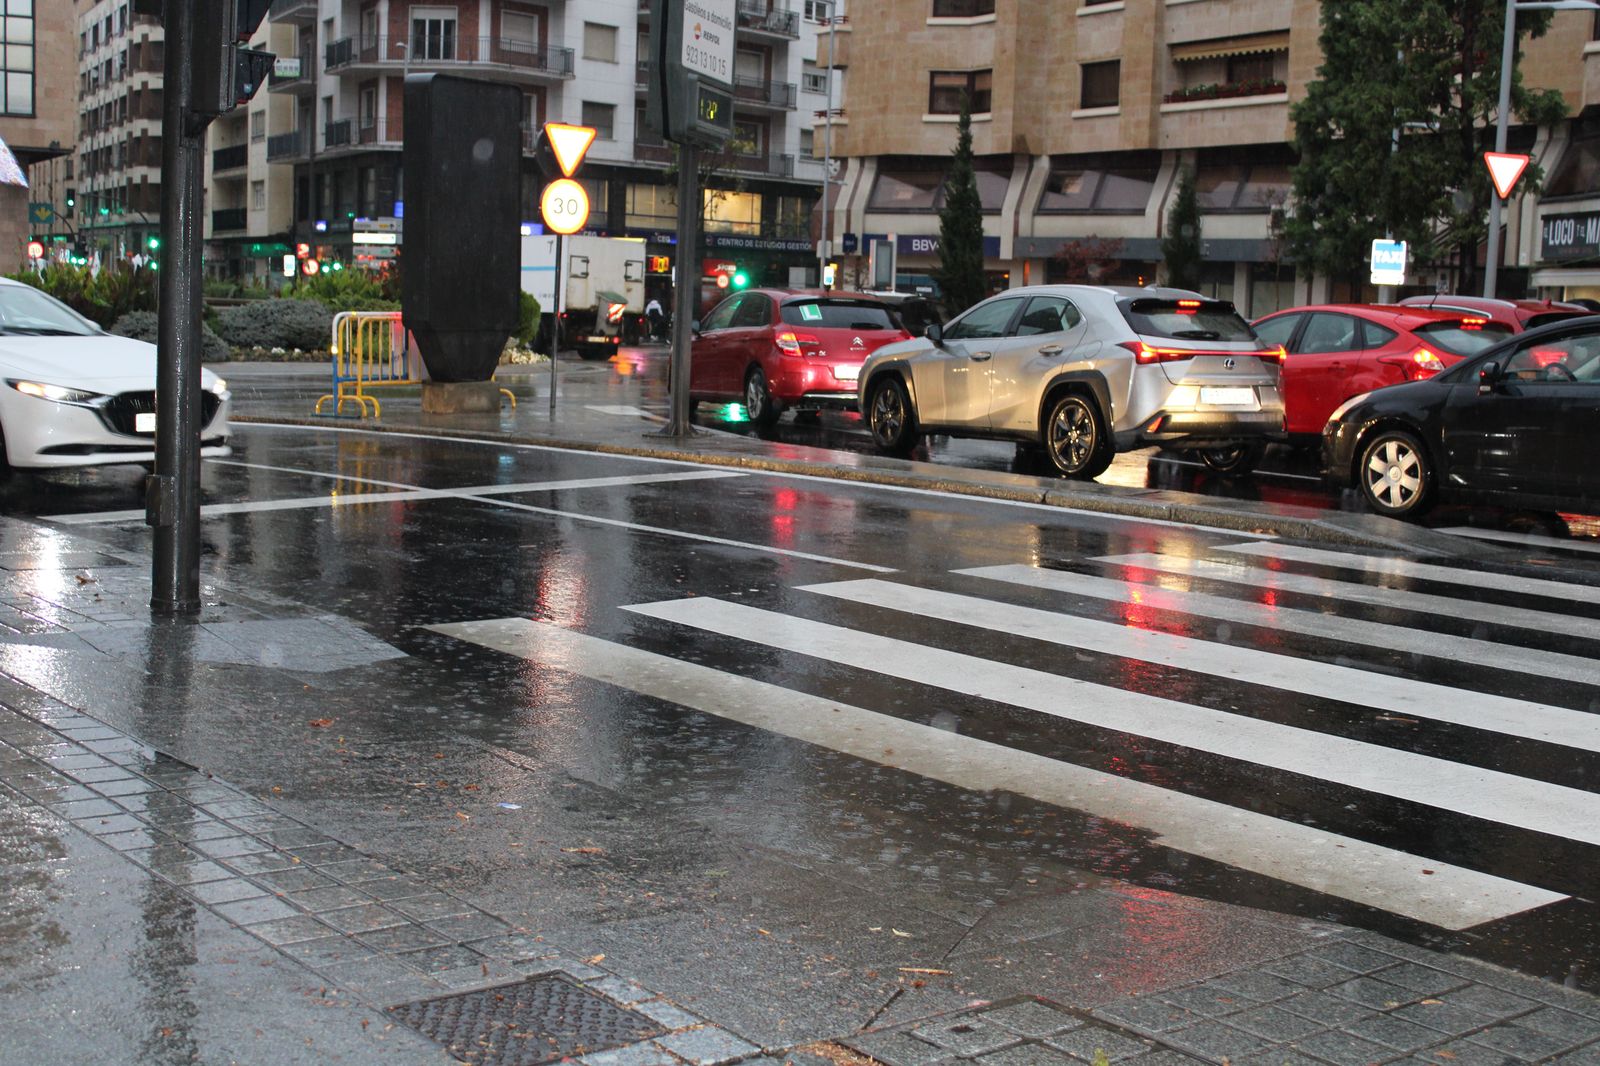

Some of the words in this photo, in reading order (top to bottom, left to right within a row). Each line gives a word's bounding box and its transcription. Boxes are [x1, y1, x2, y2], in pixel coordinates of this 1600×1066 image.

[686, 45, 698, 65] 923
[700, 51, 708, 69] 13
[709, 55, 717, 73] 10
[718, 58, 727, 76] 15
[553, 197, 578, 215] 30
[717, 238, 743, 247] CENTRO
[744, 239, 754, 248] DE
[1549, 218, 1575, 246] LOCO
